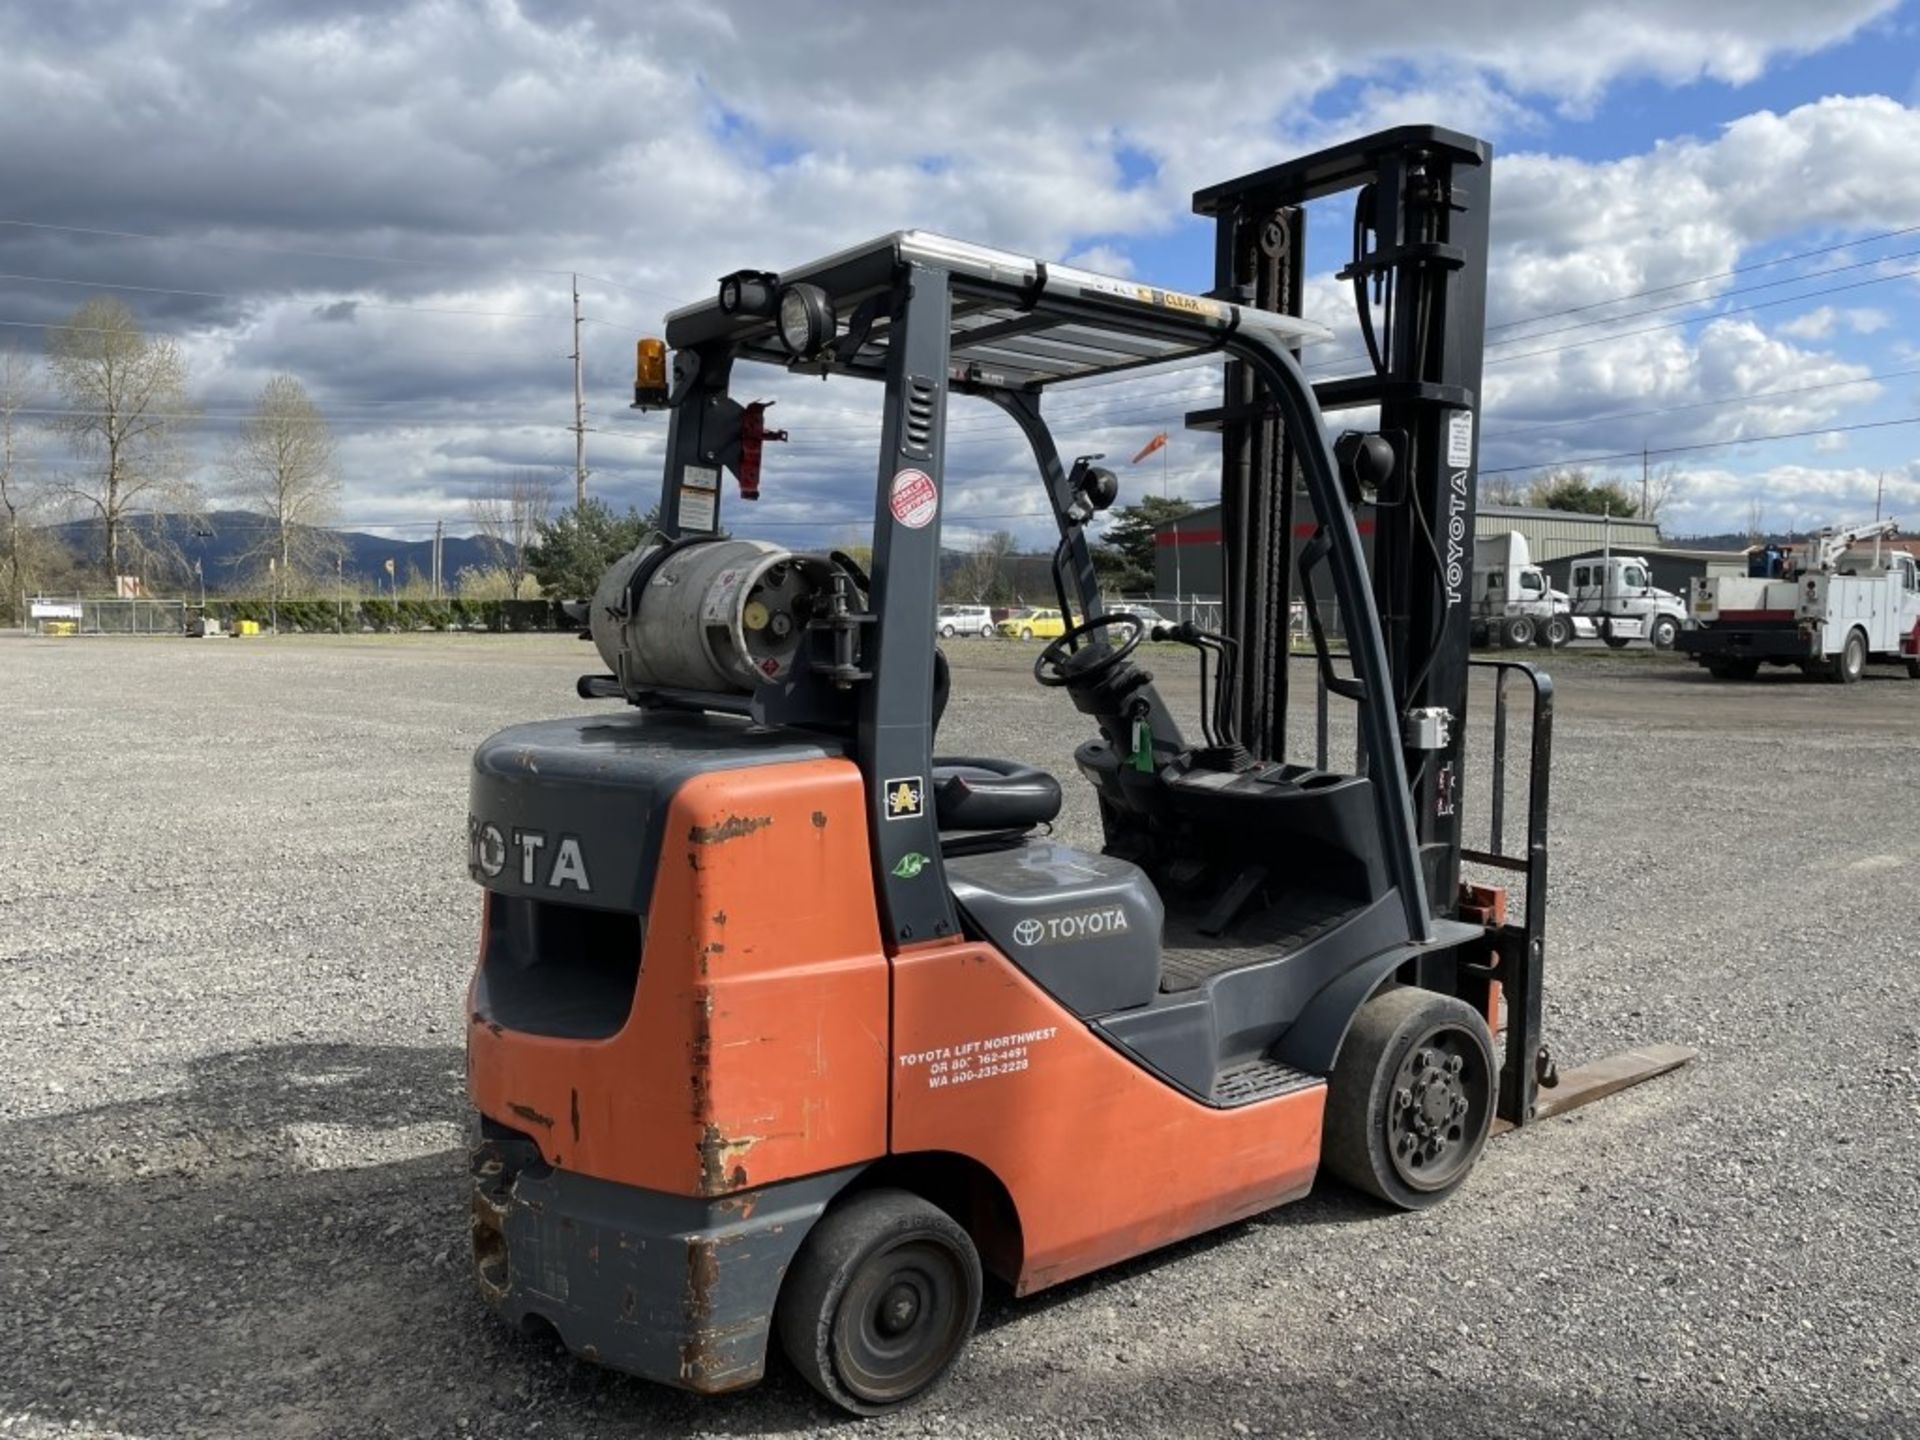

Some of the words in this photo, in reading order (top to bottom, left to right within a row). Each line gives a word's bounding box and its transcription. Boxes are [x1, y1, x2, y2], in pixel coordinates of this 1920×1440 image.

[1447, 470, 1467, 609] TOYOTA
[1048, 910, 1128, 939] TOYOTA
[899, 1048, 951, 1066] TOYOTA
[955, 1041, 982, 1057] LIFT
[983, 1027, 1058, 1051] NORTHWEST
[929, 1074, 948, 1088] WA
